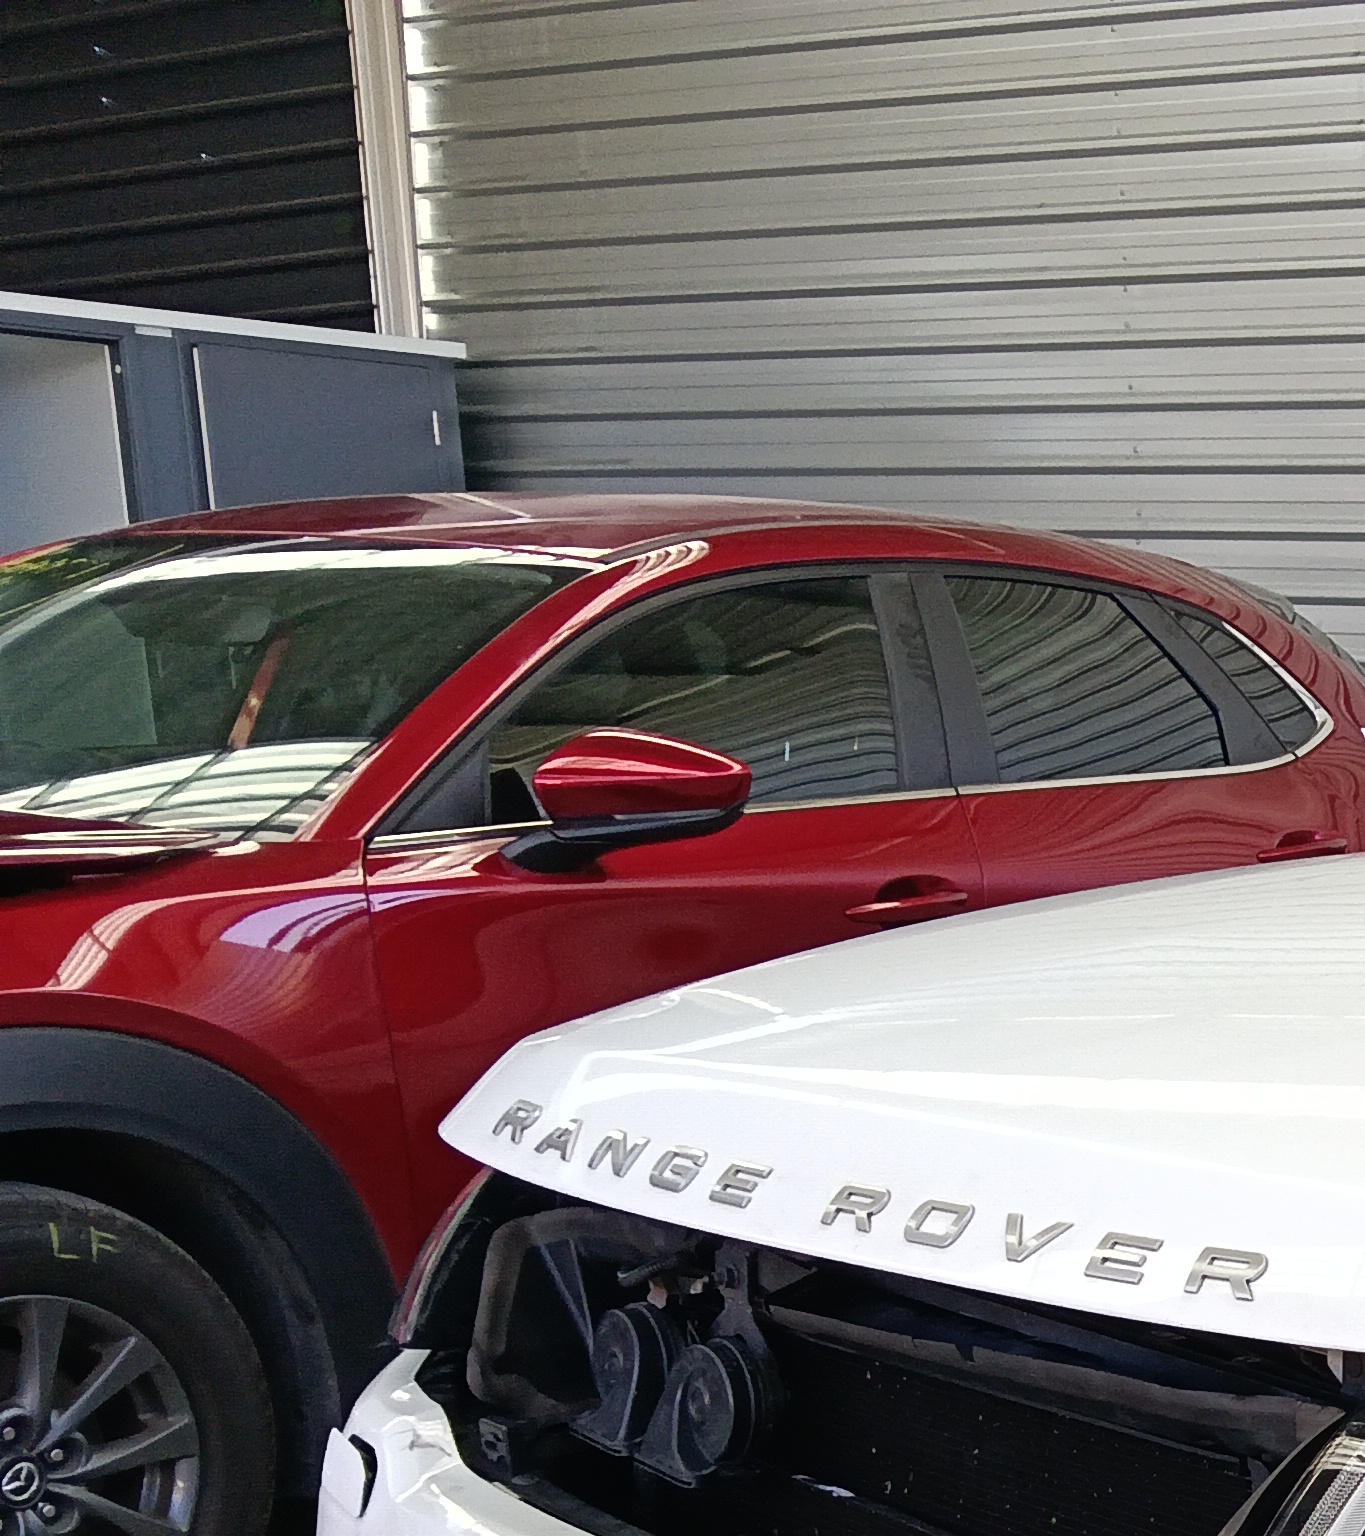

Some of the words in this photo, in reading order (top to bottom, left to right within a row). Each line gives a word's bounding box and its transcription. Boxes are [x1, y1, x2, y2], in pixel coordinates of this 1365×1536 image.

[50, 1222, 119, 1263] LF
[493, 1099, 773, 1208] RANGE
[820, 1185, 1270, 1301] ROVER
